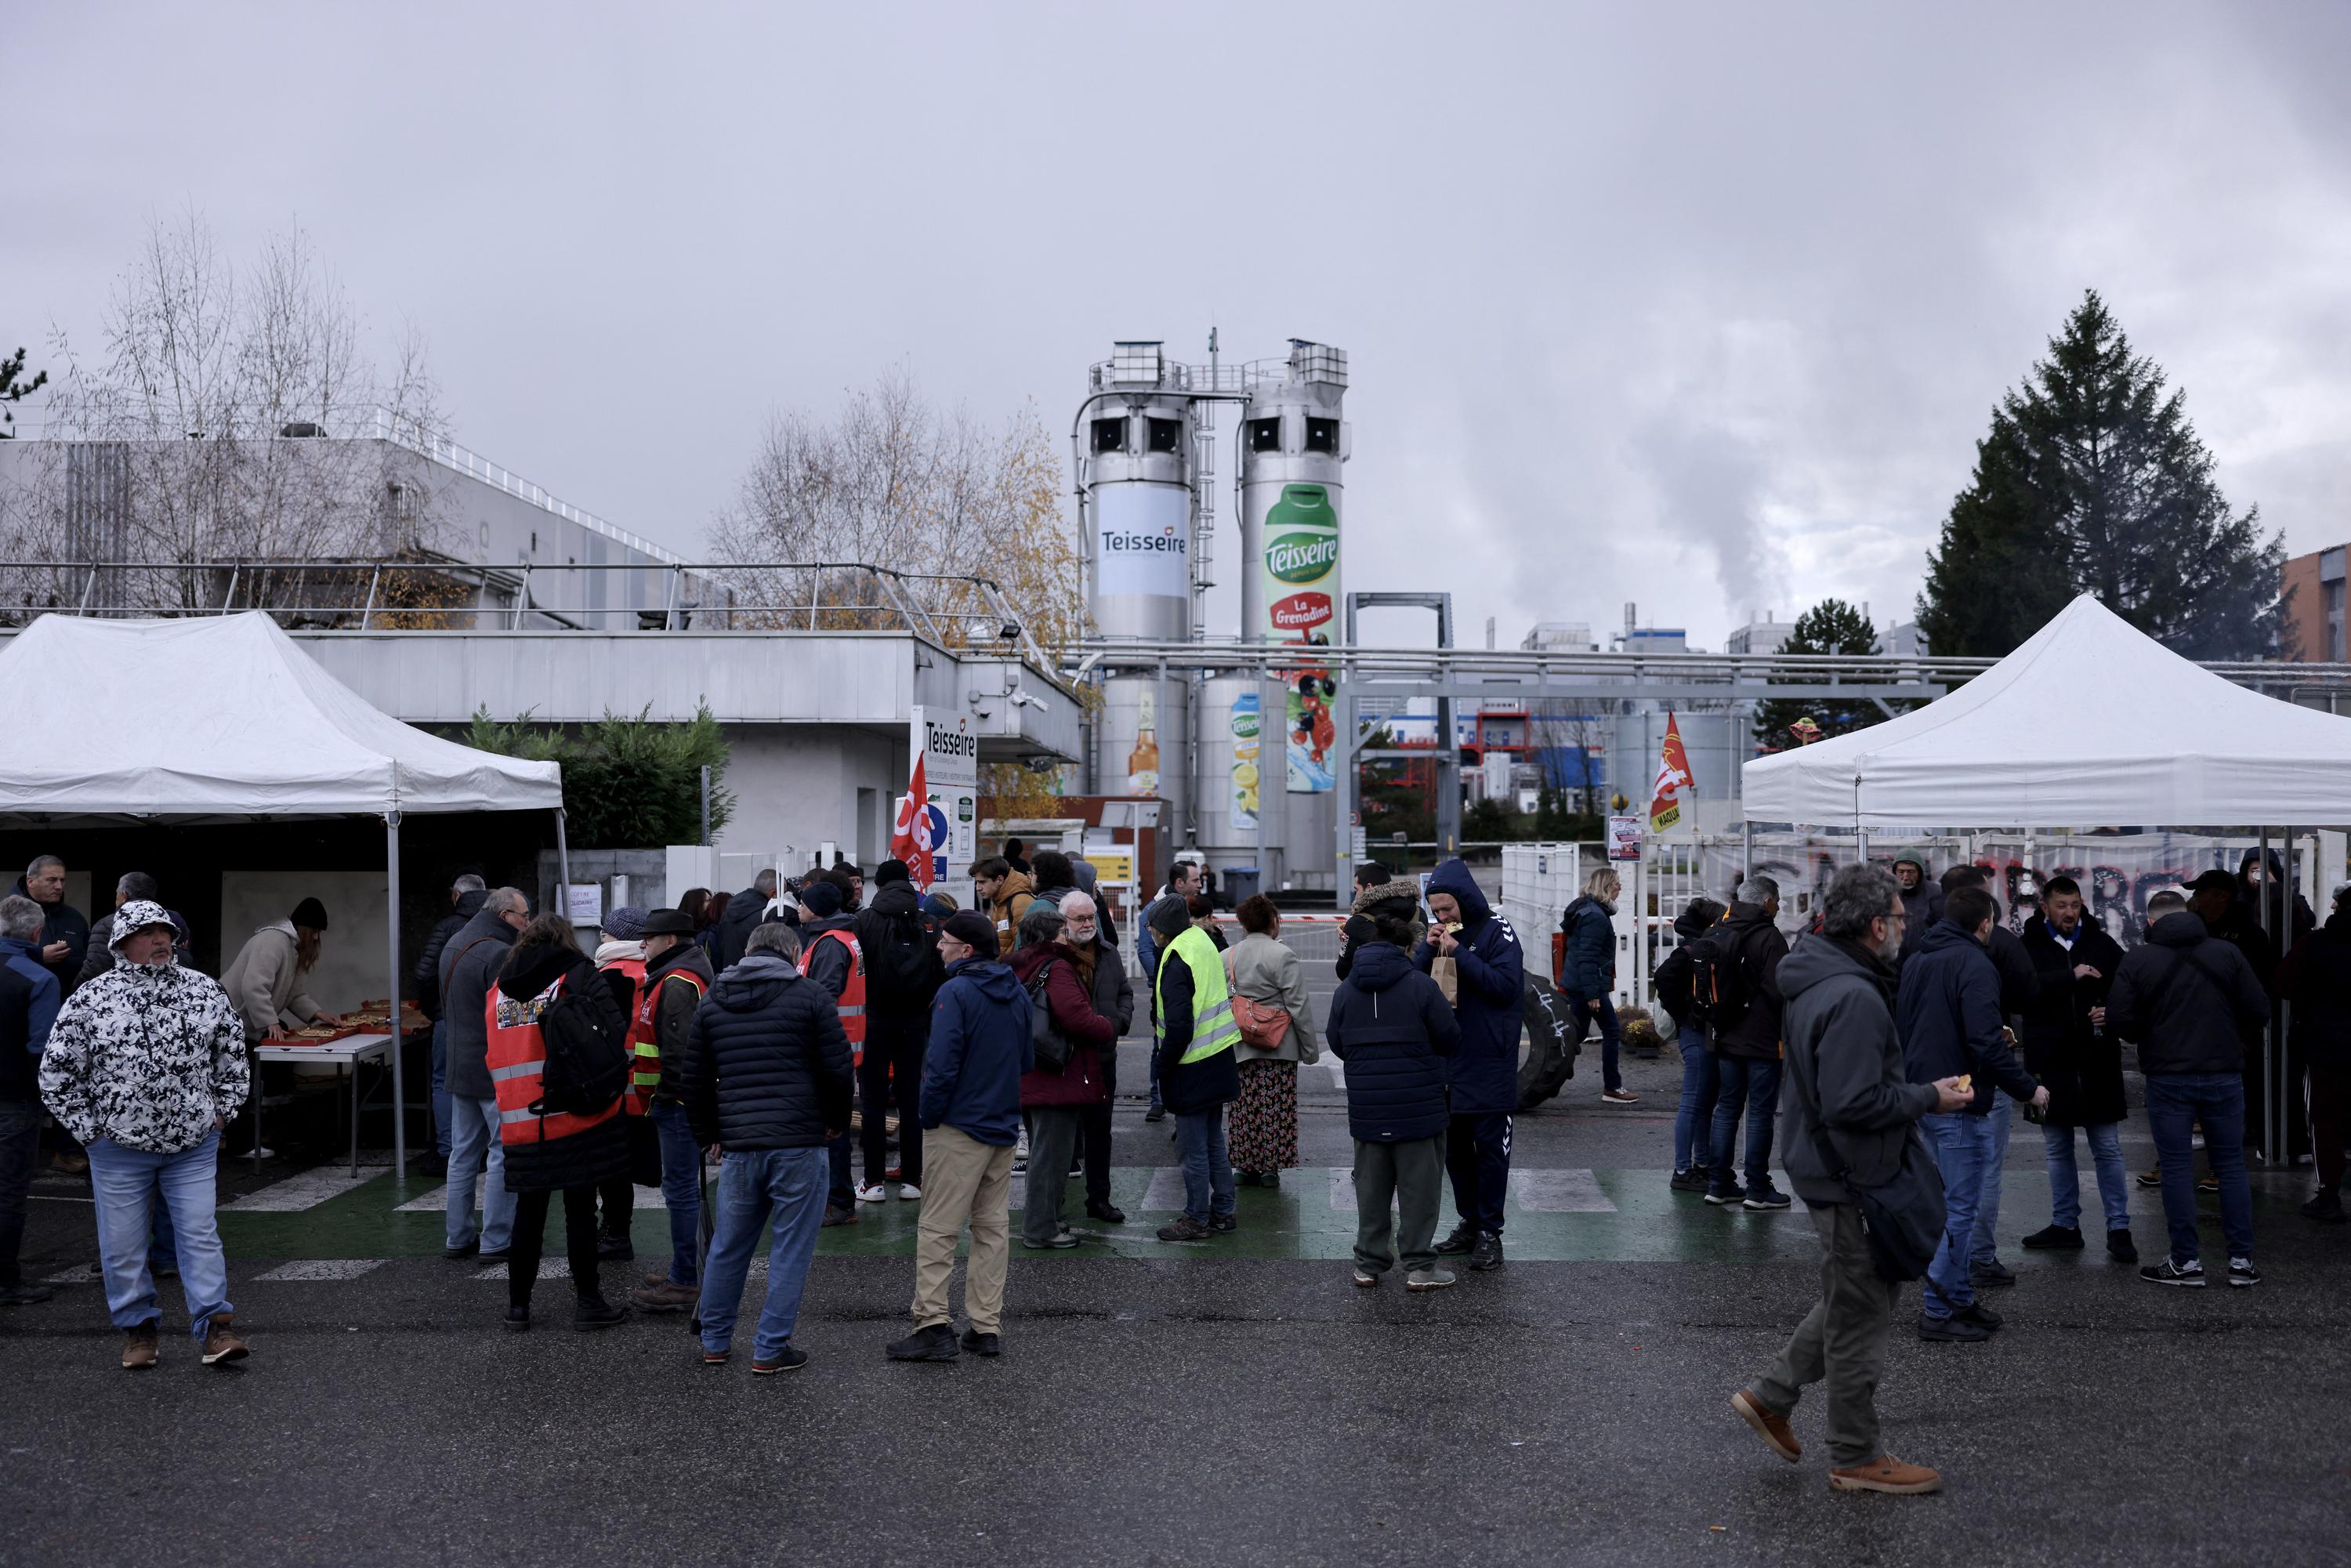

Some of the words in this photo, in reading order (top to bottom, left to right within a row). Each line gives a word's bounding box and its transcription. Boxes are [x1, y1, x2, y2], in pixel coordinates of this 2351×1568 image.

[1102, 527, 1185, 553] Teisseire
[1265, 537, 1336, 574] Teisseire
[1276, 605, 1330, 624] Grenadine
[1294, 599, 1307, 611] La
[926, 718, 975, 757] Teisseire
